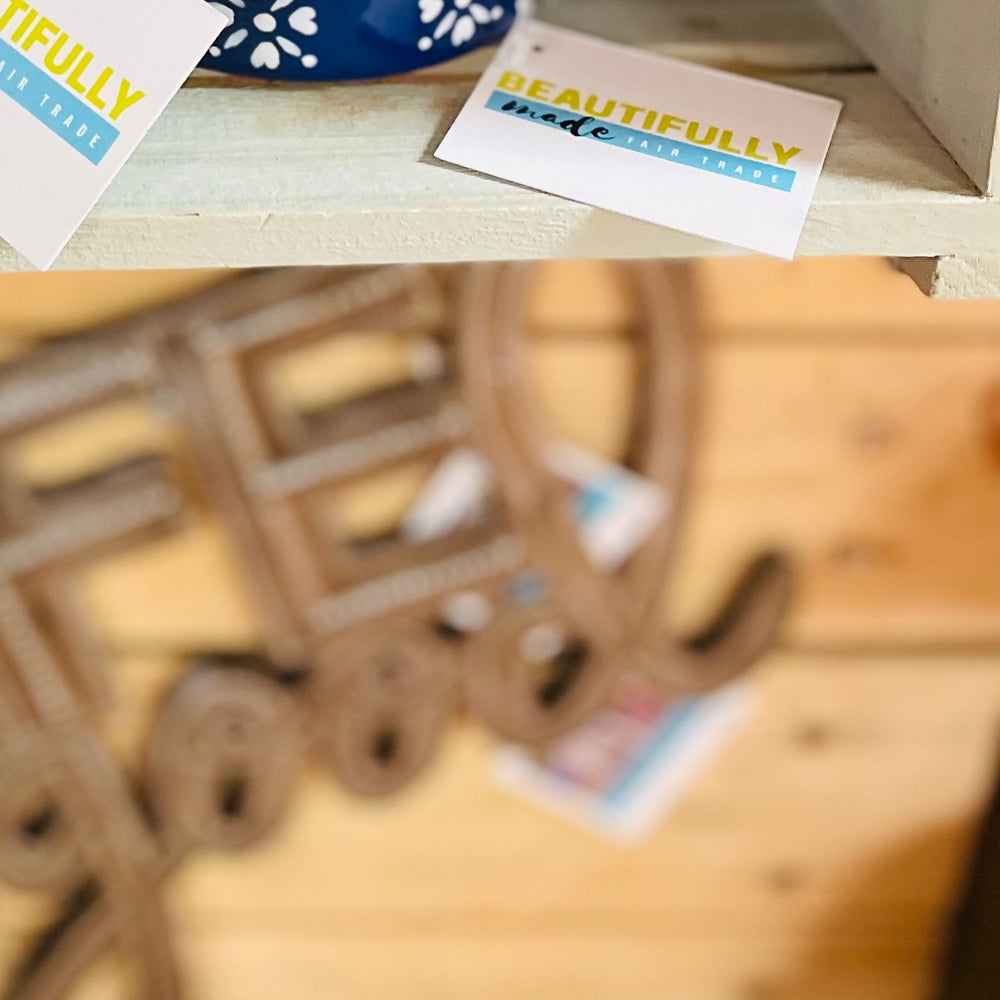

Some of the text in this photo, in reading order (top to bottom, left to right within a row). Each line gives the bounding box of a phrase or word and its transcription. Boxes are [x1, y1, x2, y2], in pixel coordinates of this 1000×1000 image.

[39, 93, 100, 149] TRADE
[497, 70, 802, 166] BEAUTIFULLY
[500, 99, 780, 184] made FAIR TRADE
